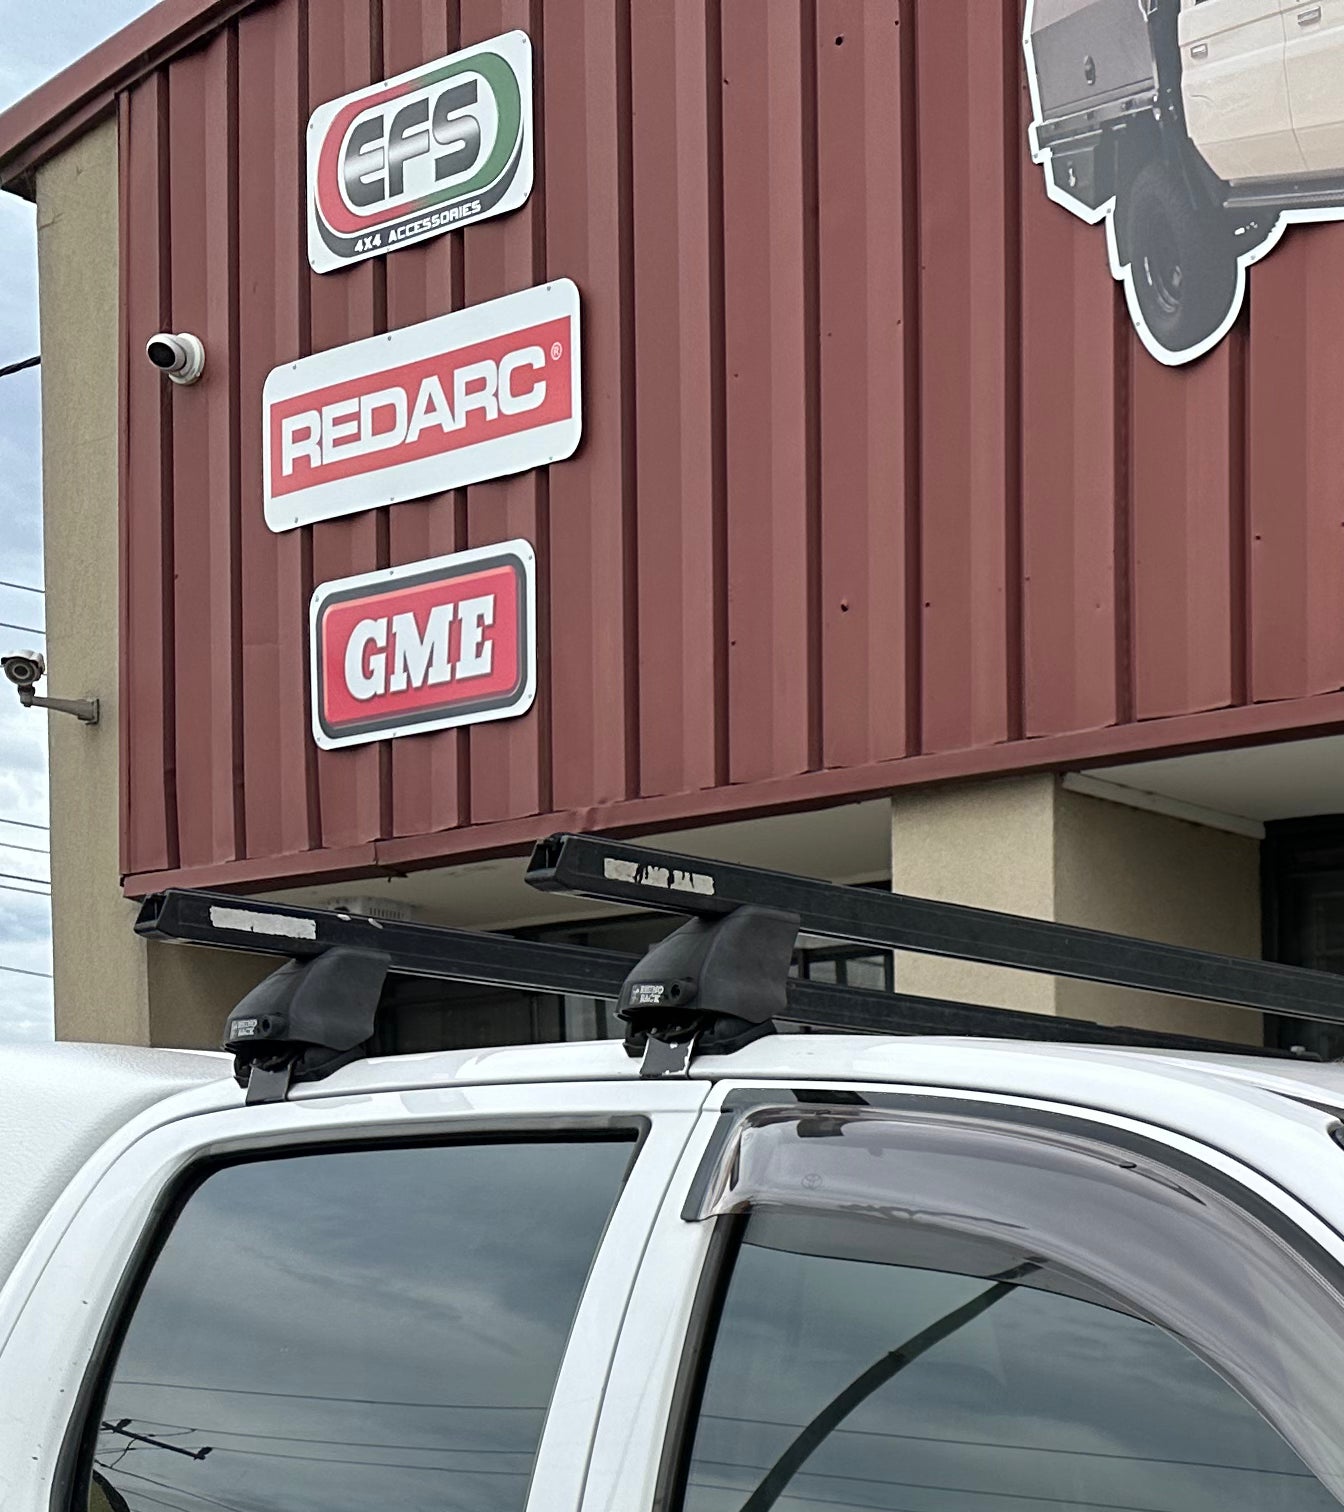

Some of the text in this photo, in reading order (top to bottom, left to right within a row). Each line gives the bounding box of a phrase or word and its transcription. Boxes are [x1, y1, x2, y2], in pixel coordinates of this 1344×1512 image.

[344, 78, 481, 207] EFS
[353, 200, 482, 253] 4X4 ACCESSORIES
[281, 346, 547, 477] REDARC
[344, 594, 495, 701] GME
